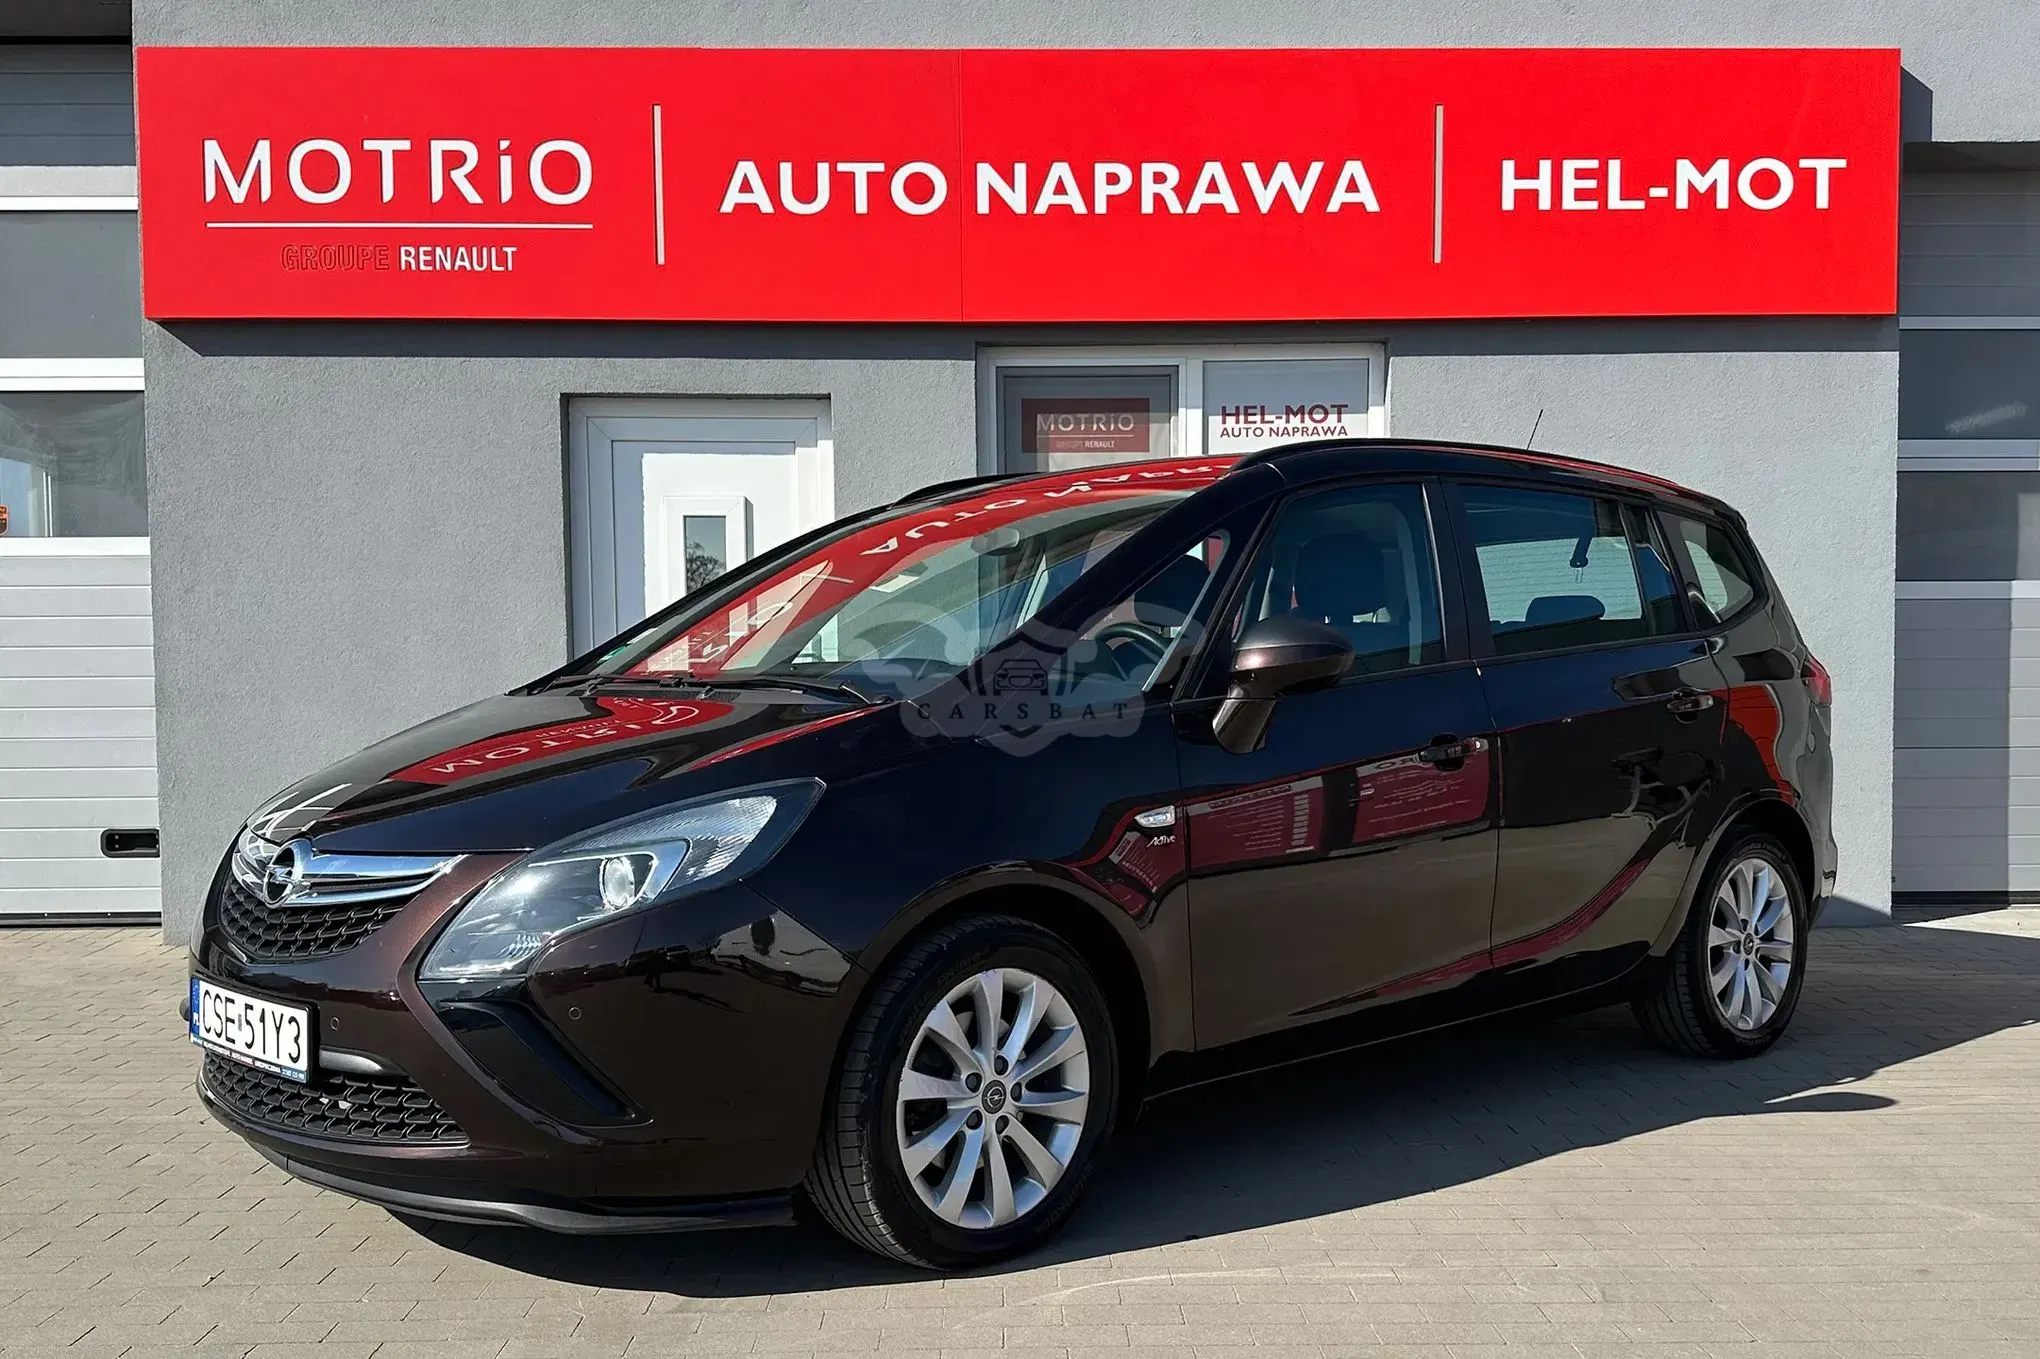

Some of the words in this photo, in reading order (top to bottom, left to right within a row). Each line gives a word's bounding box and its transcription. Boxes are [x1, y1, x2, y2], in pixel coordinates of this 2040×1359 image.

[719, 160, 947, 215] AUTO
[974, 160, 1381, 215] NAPRAWA
[1501, 157, 1848, 212] HEL-MOT
[281, 244, 390, 272] GROUPE
[399, 245, 517, 272] RENAULT
[1221, 404, 1348, 425] HEL-MOT
[1084, 440, 1115, 449] RENAULT
[1220, 426, 1264, 438] AUTO
[1269, 425, 1348, 438] NAPRAWA
[203, 989, 236, 1044] CSE
[245, 1003, 301, 1064] 51Y3
